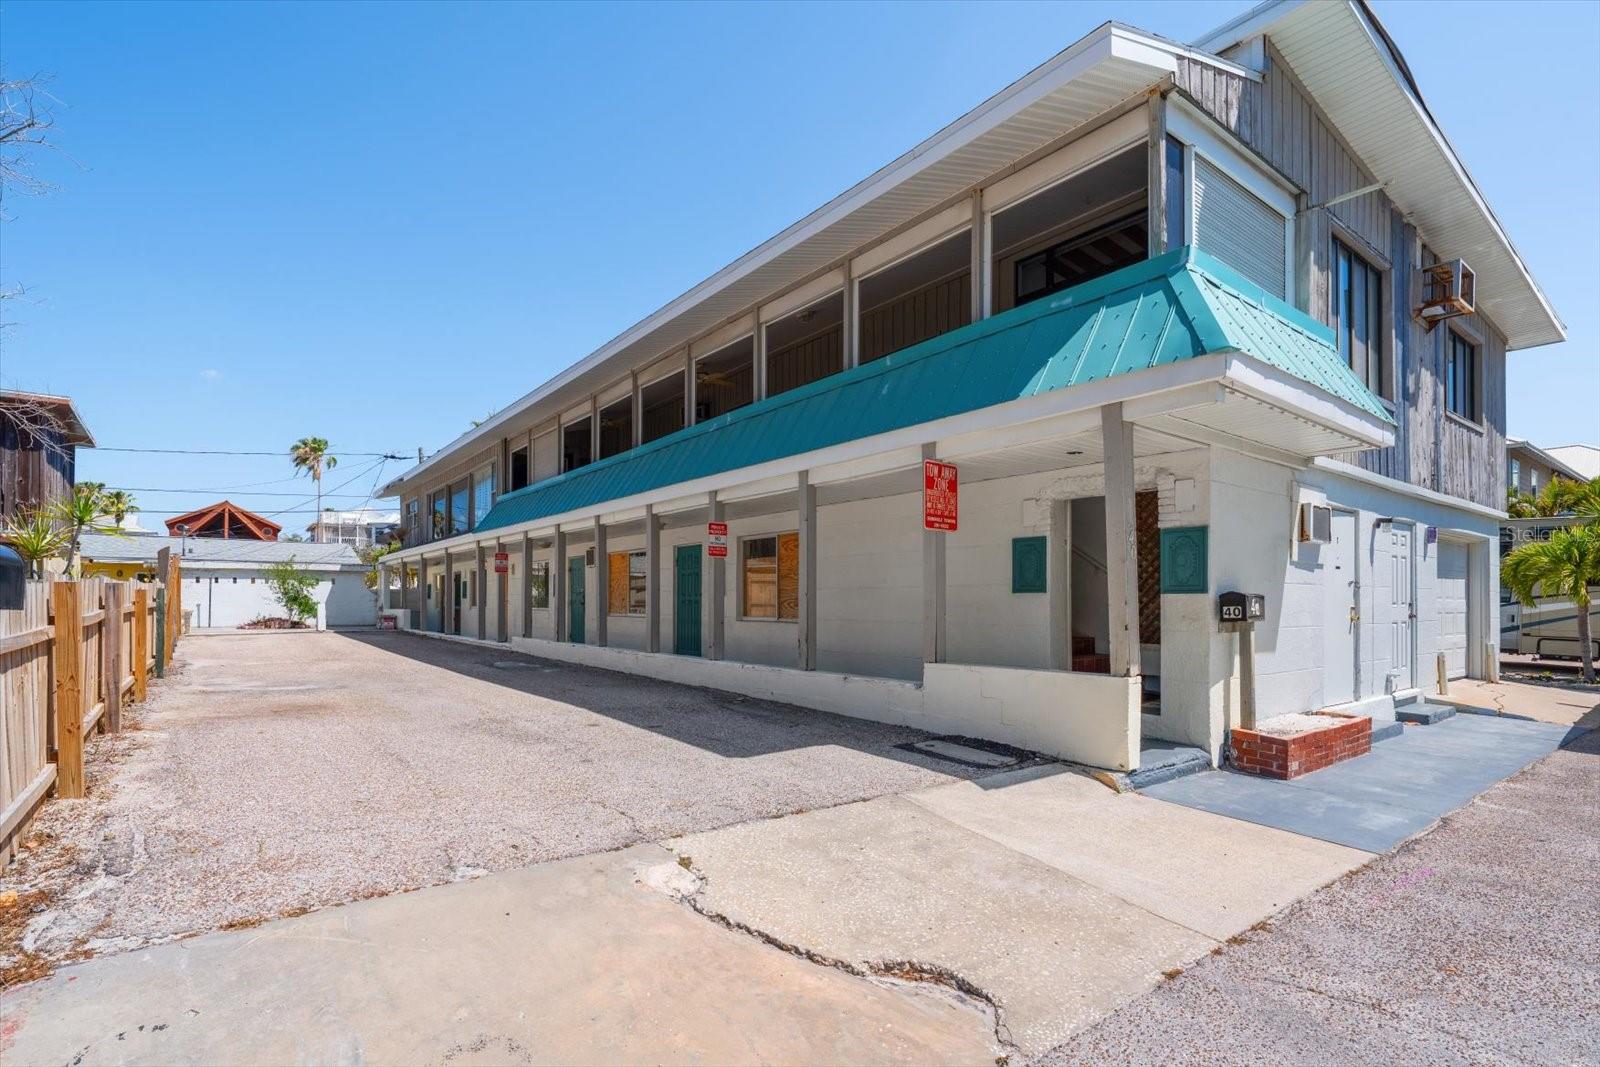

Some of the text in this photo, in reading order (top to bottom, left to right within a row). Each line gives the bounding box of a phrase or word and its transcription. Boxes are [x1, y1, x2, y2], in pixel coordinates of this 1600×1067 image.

[926, 463, 939, 478] TOW
[933, 477, 950, 491] ZONE
[1224, 607, 1241, 617] 40
